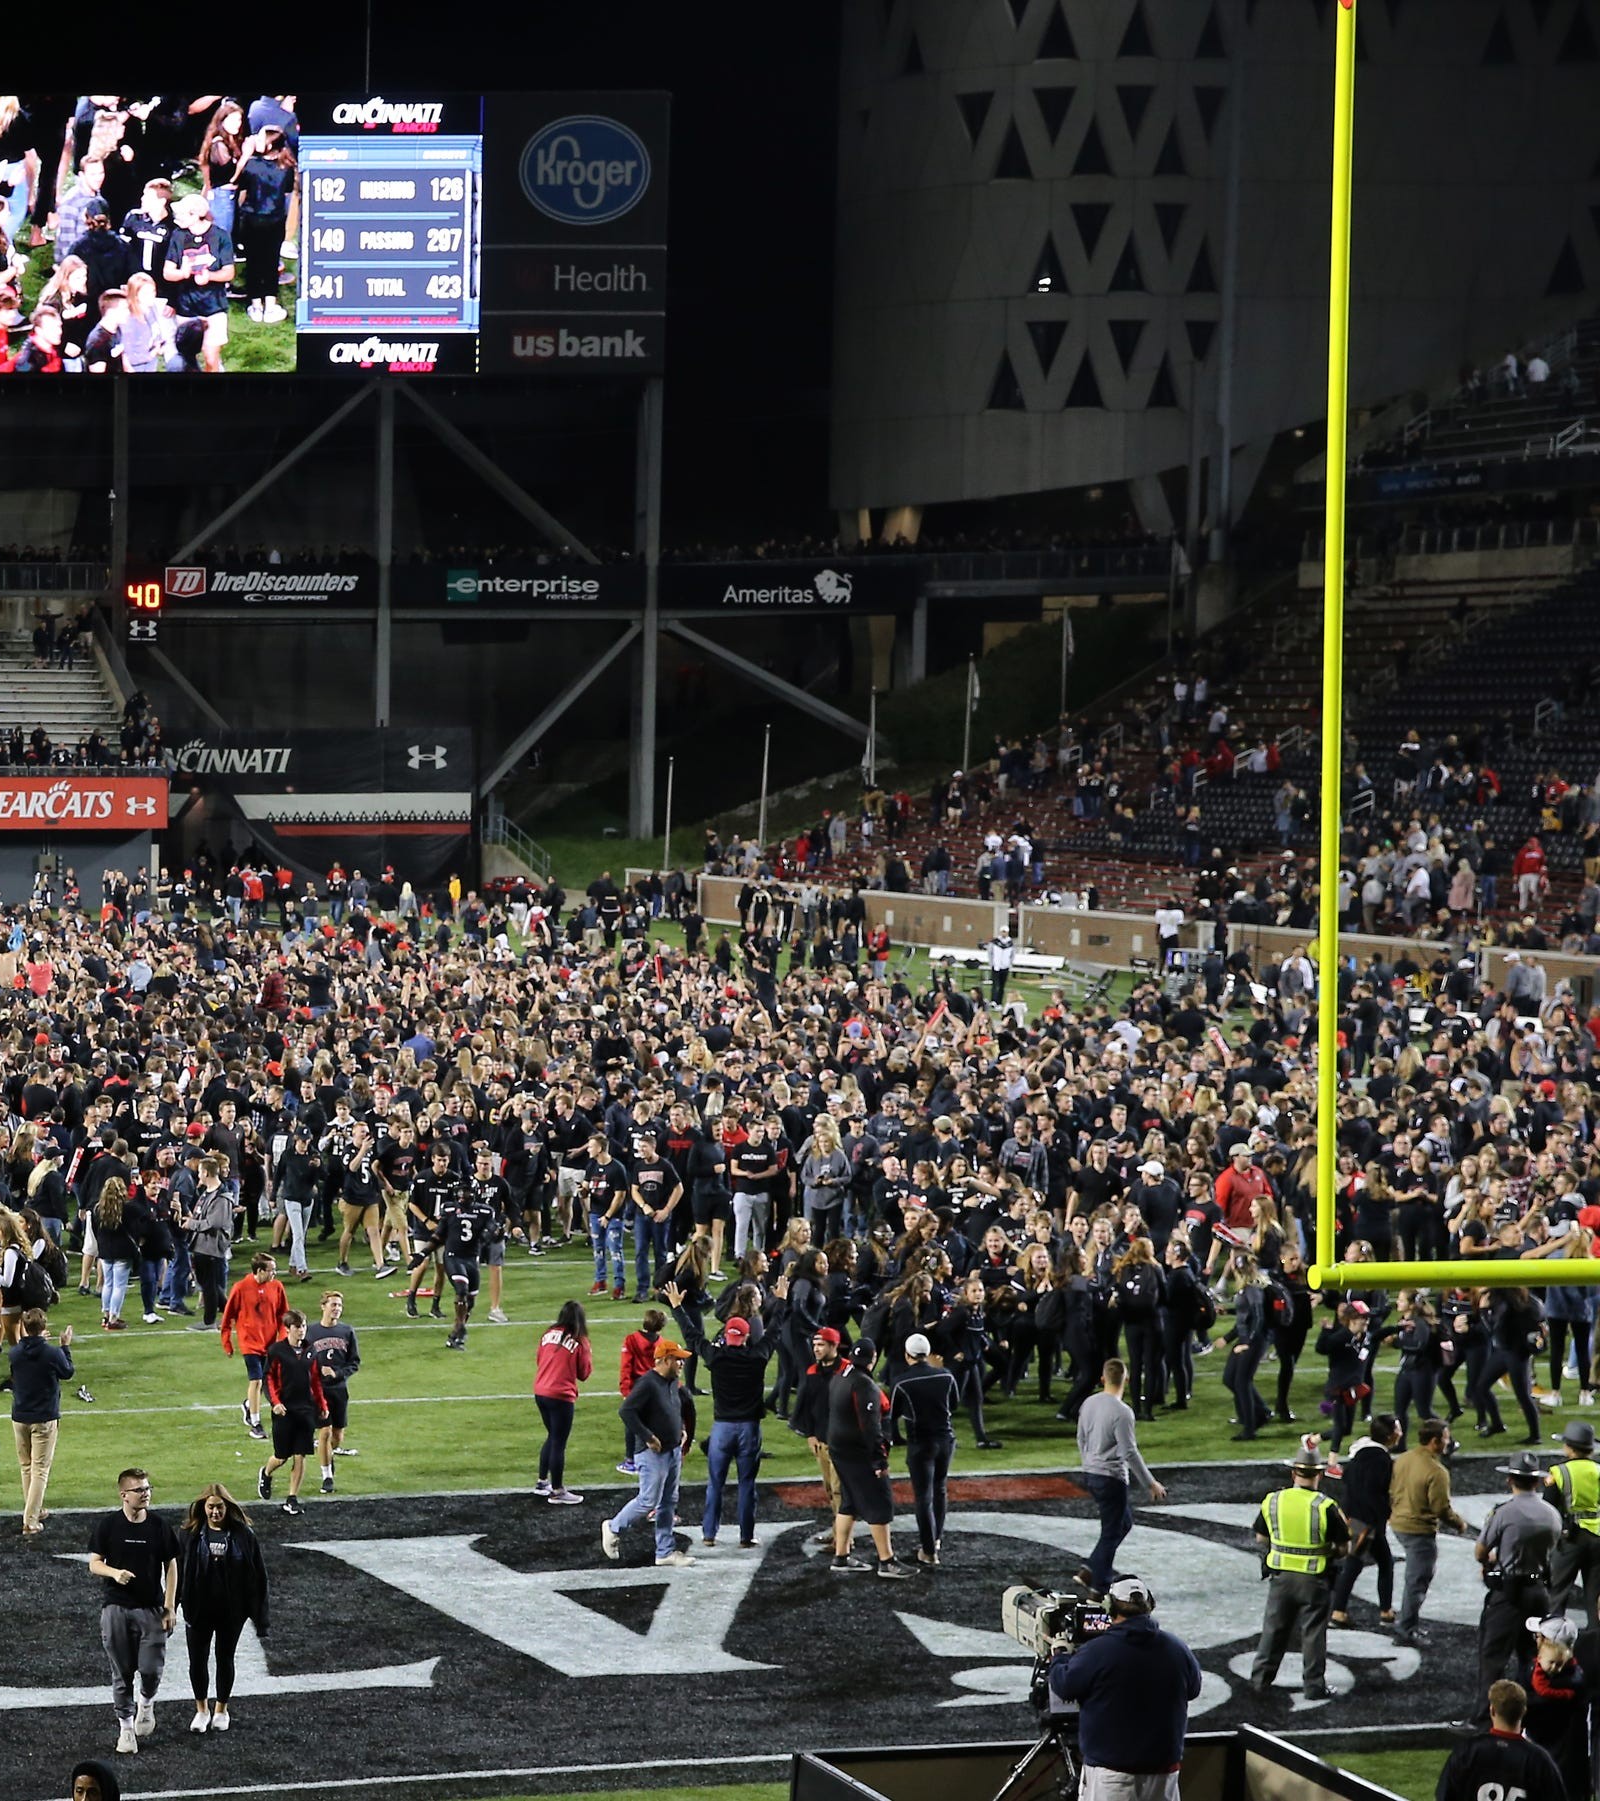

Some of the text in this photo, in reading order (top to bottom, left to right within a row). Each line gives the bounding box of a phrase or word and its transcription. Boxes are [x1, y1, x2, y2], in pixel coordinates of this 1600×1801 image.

[332, 97, 443, 124] CINCINNATI
[536, 135, 637, 209] Kroger
[312, 177, 346, 202] 192
[430, 177, 463, 202] 126
[312, 228, 462, 252] 149 PASSING 297
[309, 275, 462, 299] 341 TOTAL 423
[554, 264, 647, 291] Health
[329, 336, 440, 363] CINCINNATI
[389, 361, 434, 372] BEARCATS
[172, 571, 202, 592] TD
[456, 576, 599, 595] enterprise
[127, 584, 160, 608] 40
[723, 584, 813, 604] Ameritas
[361, 1163, 369, 1184] 5
[460, 1220, 473, 1242] 3
